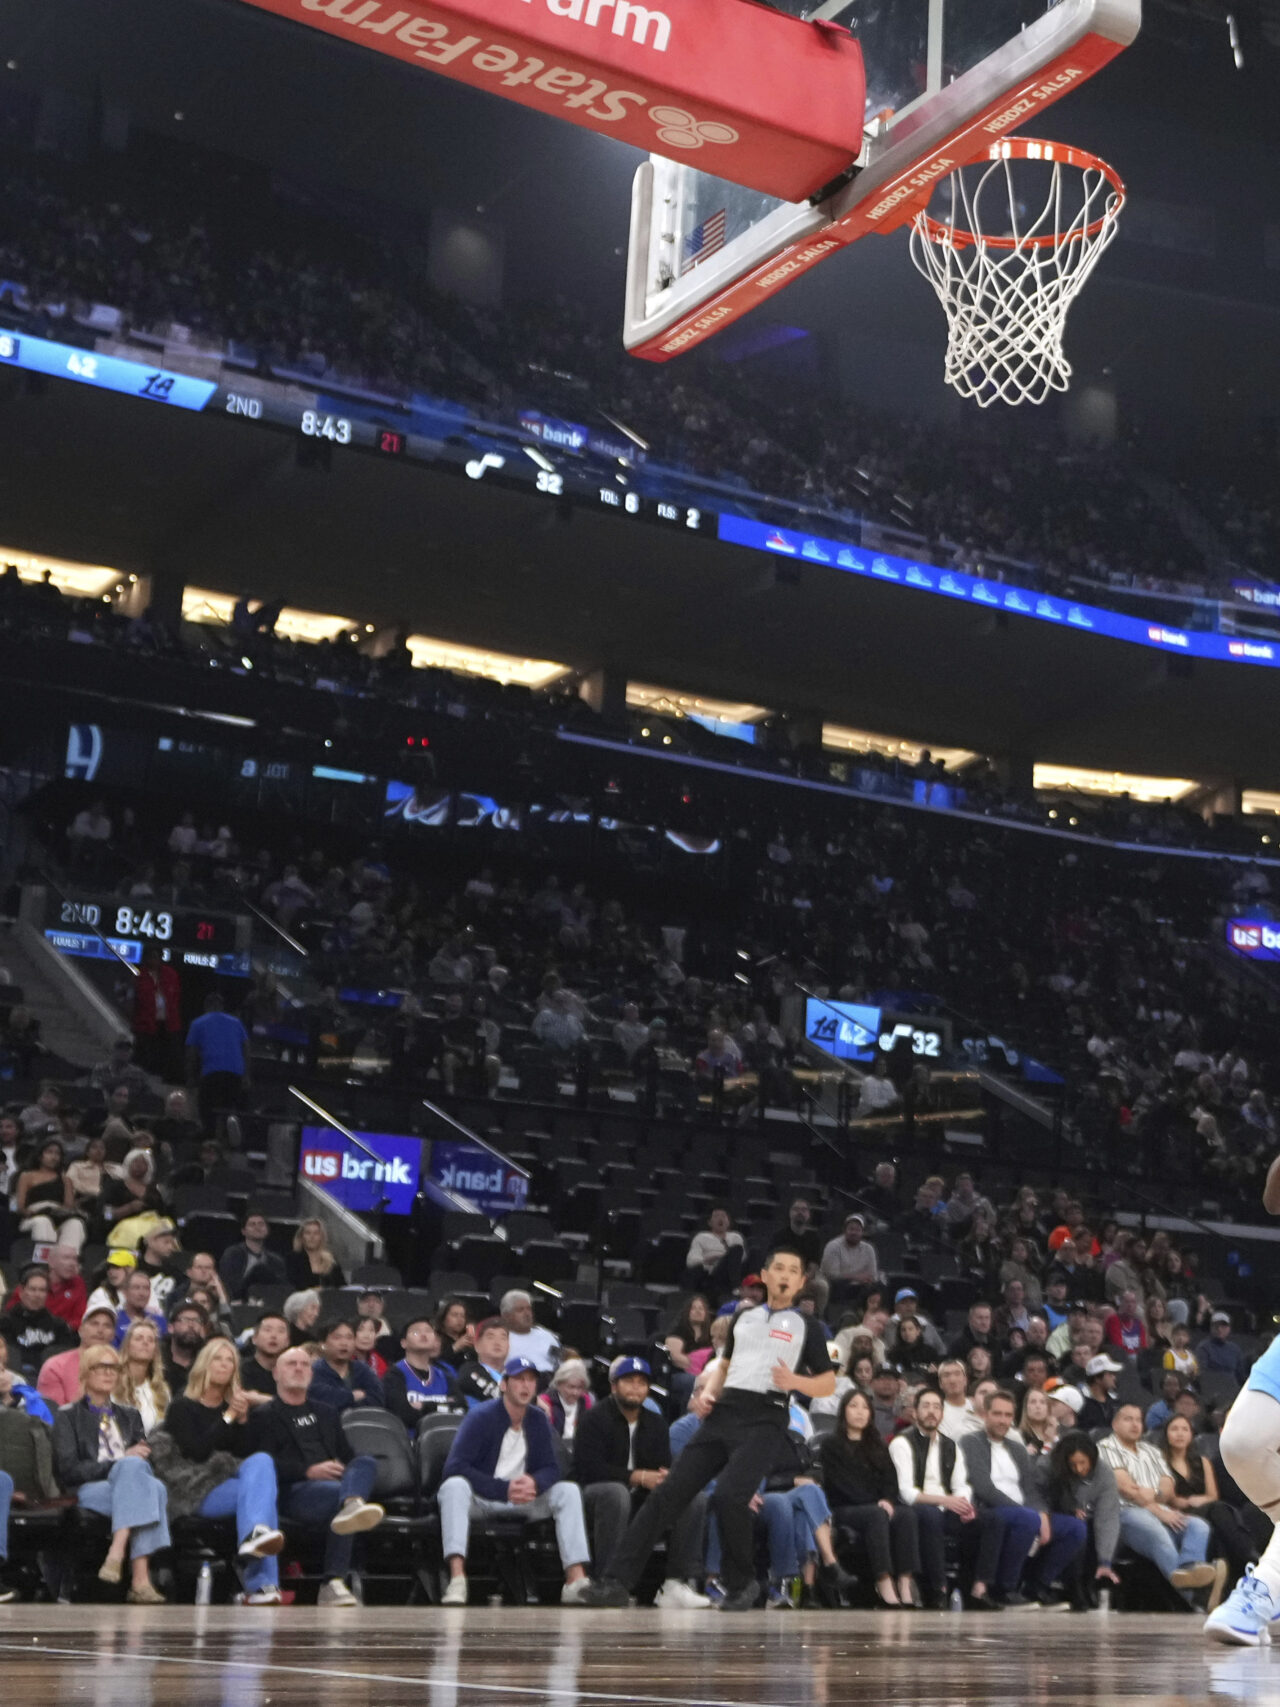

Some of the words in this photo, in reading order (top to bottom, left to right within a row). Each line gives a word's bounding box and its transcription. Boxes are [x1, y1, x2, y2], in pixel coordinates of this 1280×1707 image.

[983, 98, 1036, 134] HERDEZ
[1031, 67, 1083, 100] SALSA
[866, 186, 914, 220] HERDEZ
[910, 157, 955, 187] SALSA
[756, 260, 801, 288] HERDEZ
[797, 240, 839, 262] SALSA
[660, 328, 698, 353] HERDEZ
[695, 306, 733, 330] SALSA
[67, 353, 97, 379] 42
[226, 393, 262, 419] 2ND
[301, 410, 351, 444] 8:43
[381, 432, 400, 453] 21
[542, 424, 583, 448] bank
[536, 470, 563, 495] 32
[625, 491, 640, 514] 6
[686, 507, 700, 529] 2
[61, 903, 99, 926] 2ND
[115, 906, 173, 940] 8:43
[1233, 928, 1258, 946] us
[912, 1030, 941, 1057] 32
[304, 1153, 337, 1177] us
